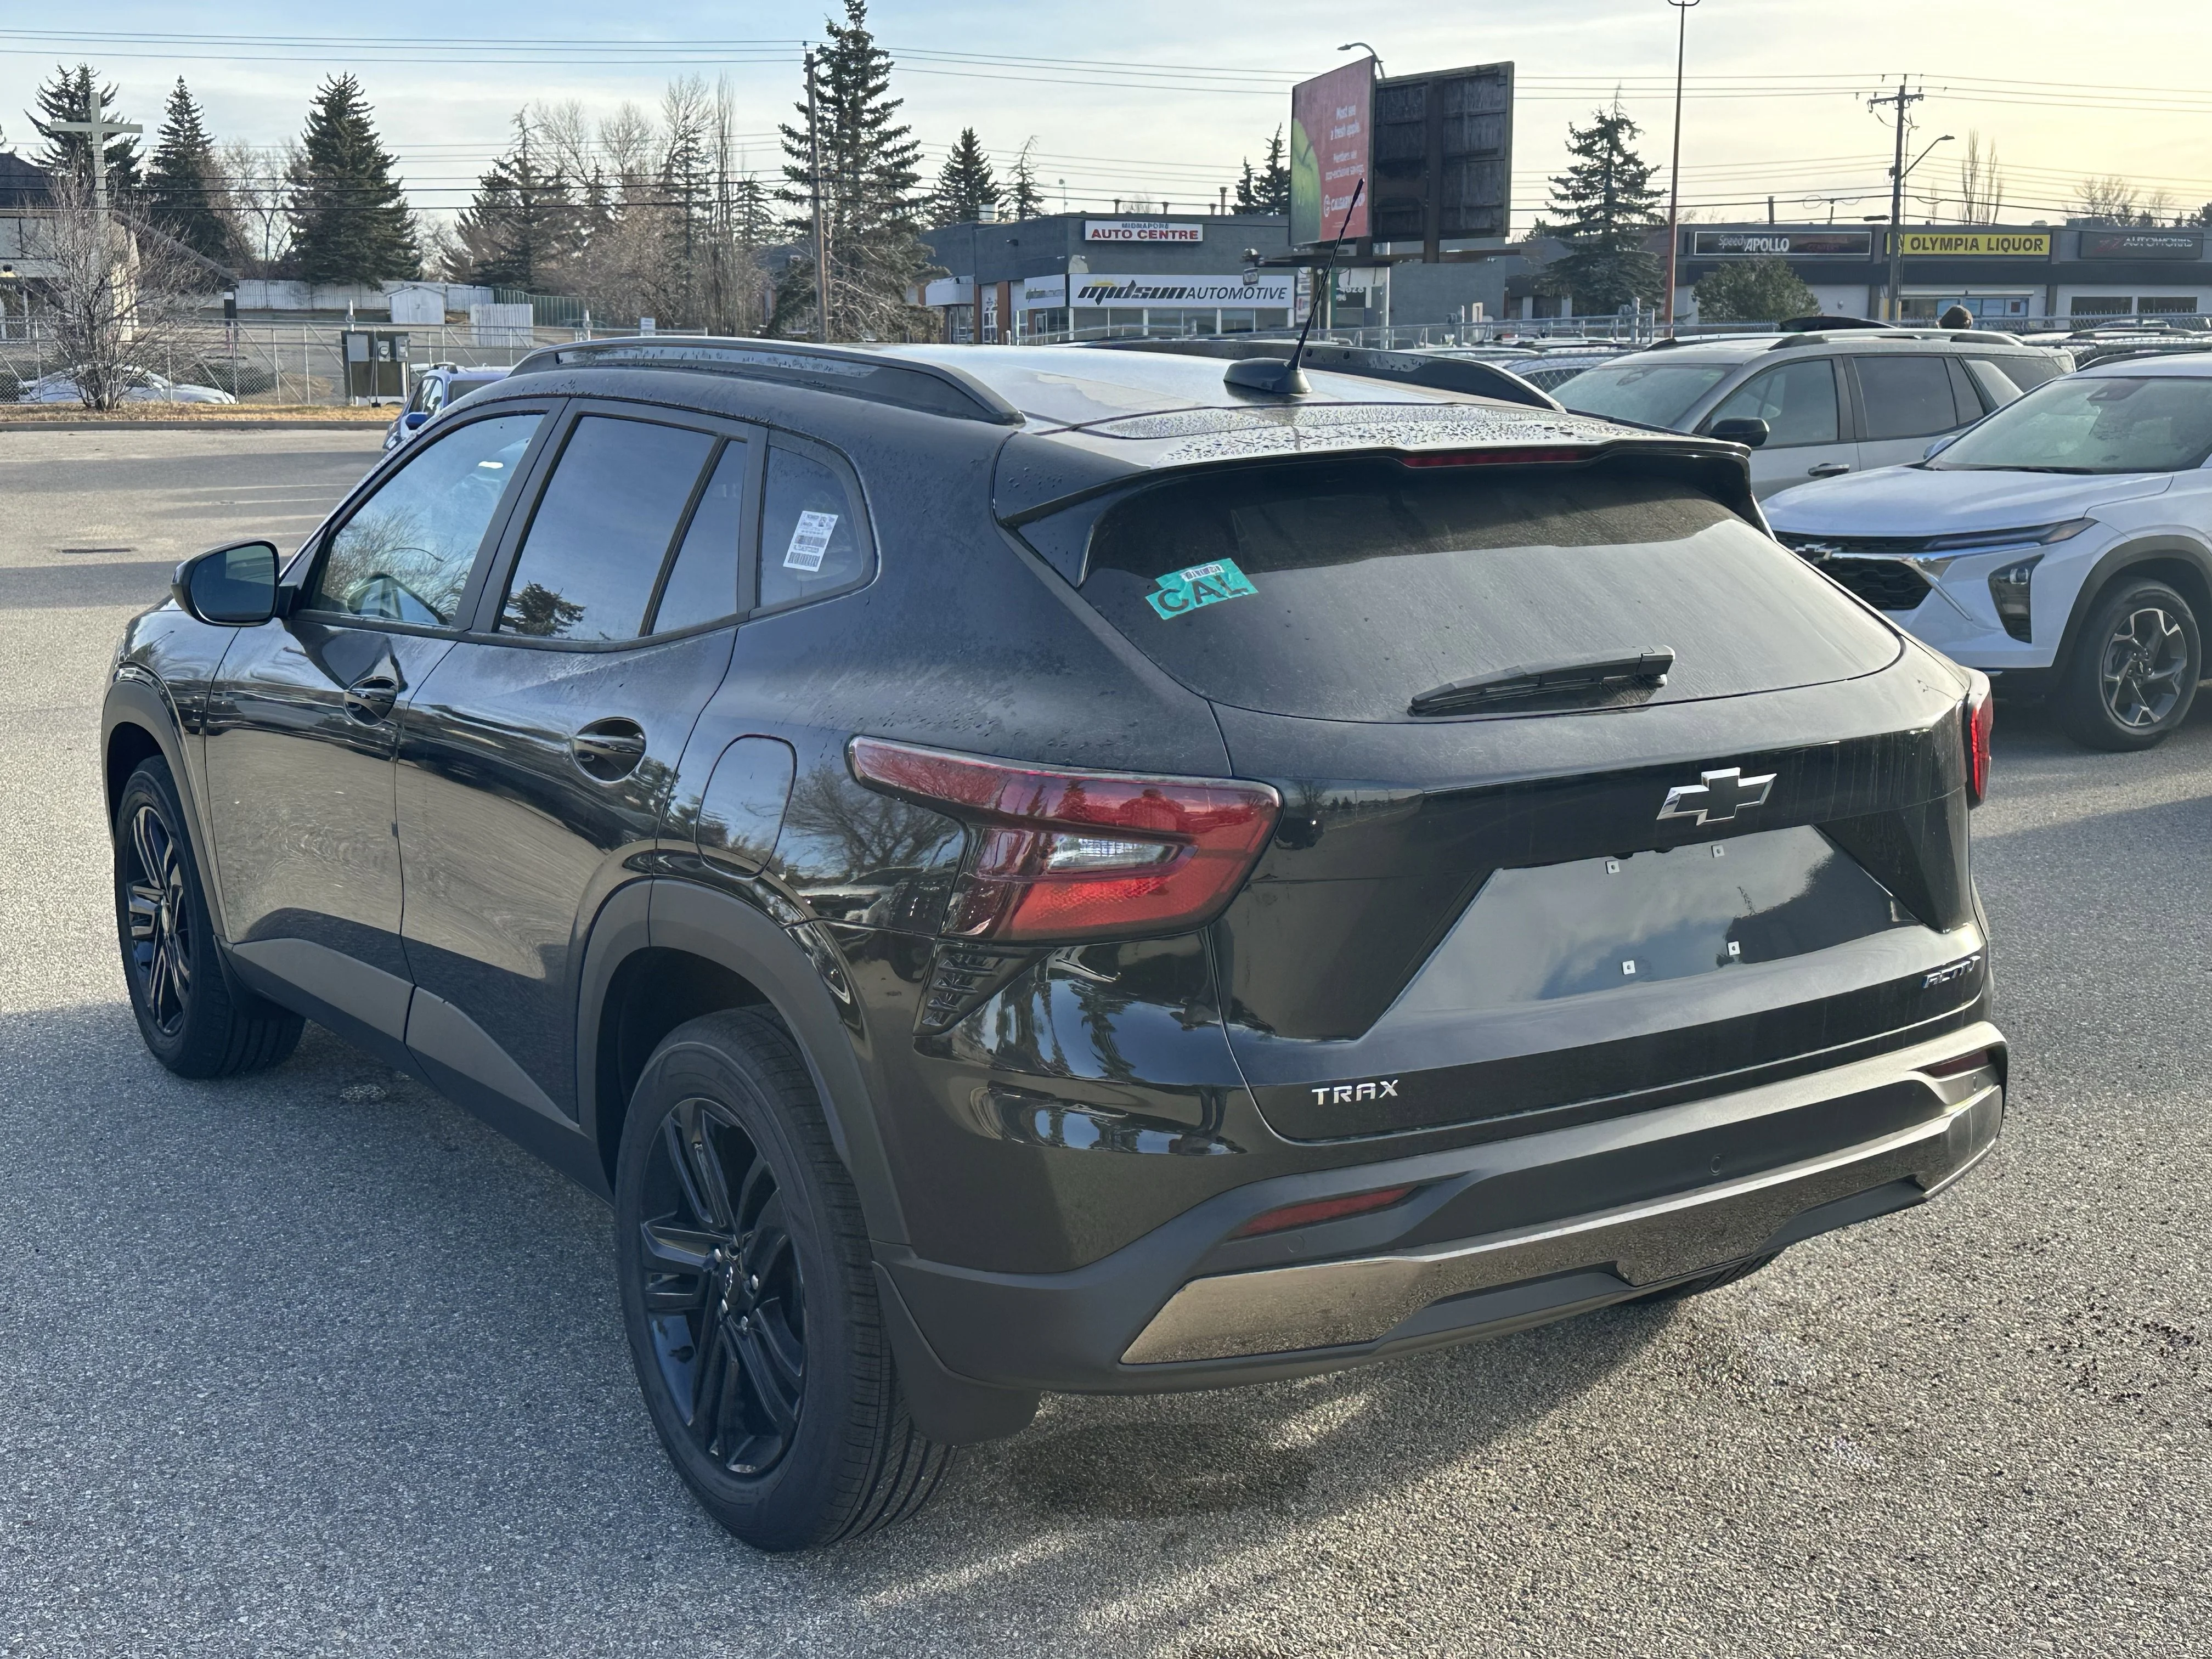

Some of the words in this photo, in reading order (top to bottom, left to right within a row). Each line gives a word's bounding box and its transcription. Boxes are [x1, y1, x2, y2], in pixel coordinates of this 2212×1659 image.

[1091, 229, 1133, 239] AUTO
[1137, 230, 1199, 240] CENTRE
[1744, 238, 1790, 252] APOLLO
[1910, 237, 1979, 251] OLYMPIA
[1987, 238, 2043, 253] LIQUOR
[1077, 280, 1188, 305] midsun
[1186, 286, 1288, 300] AUTOMOTIVE
[1158, 574, 1249, 612] CAL
[1922, 956, 1981, 988] ACTIV
[1312, 1079, 1398, 1105] TRAX
